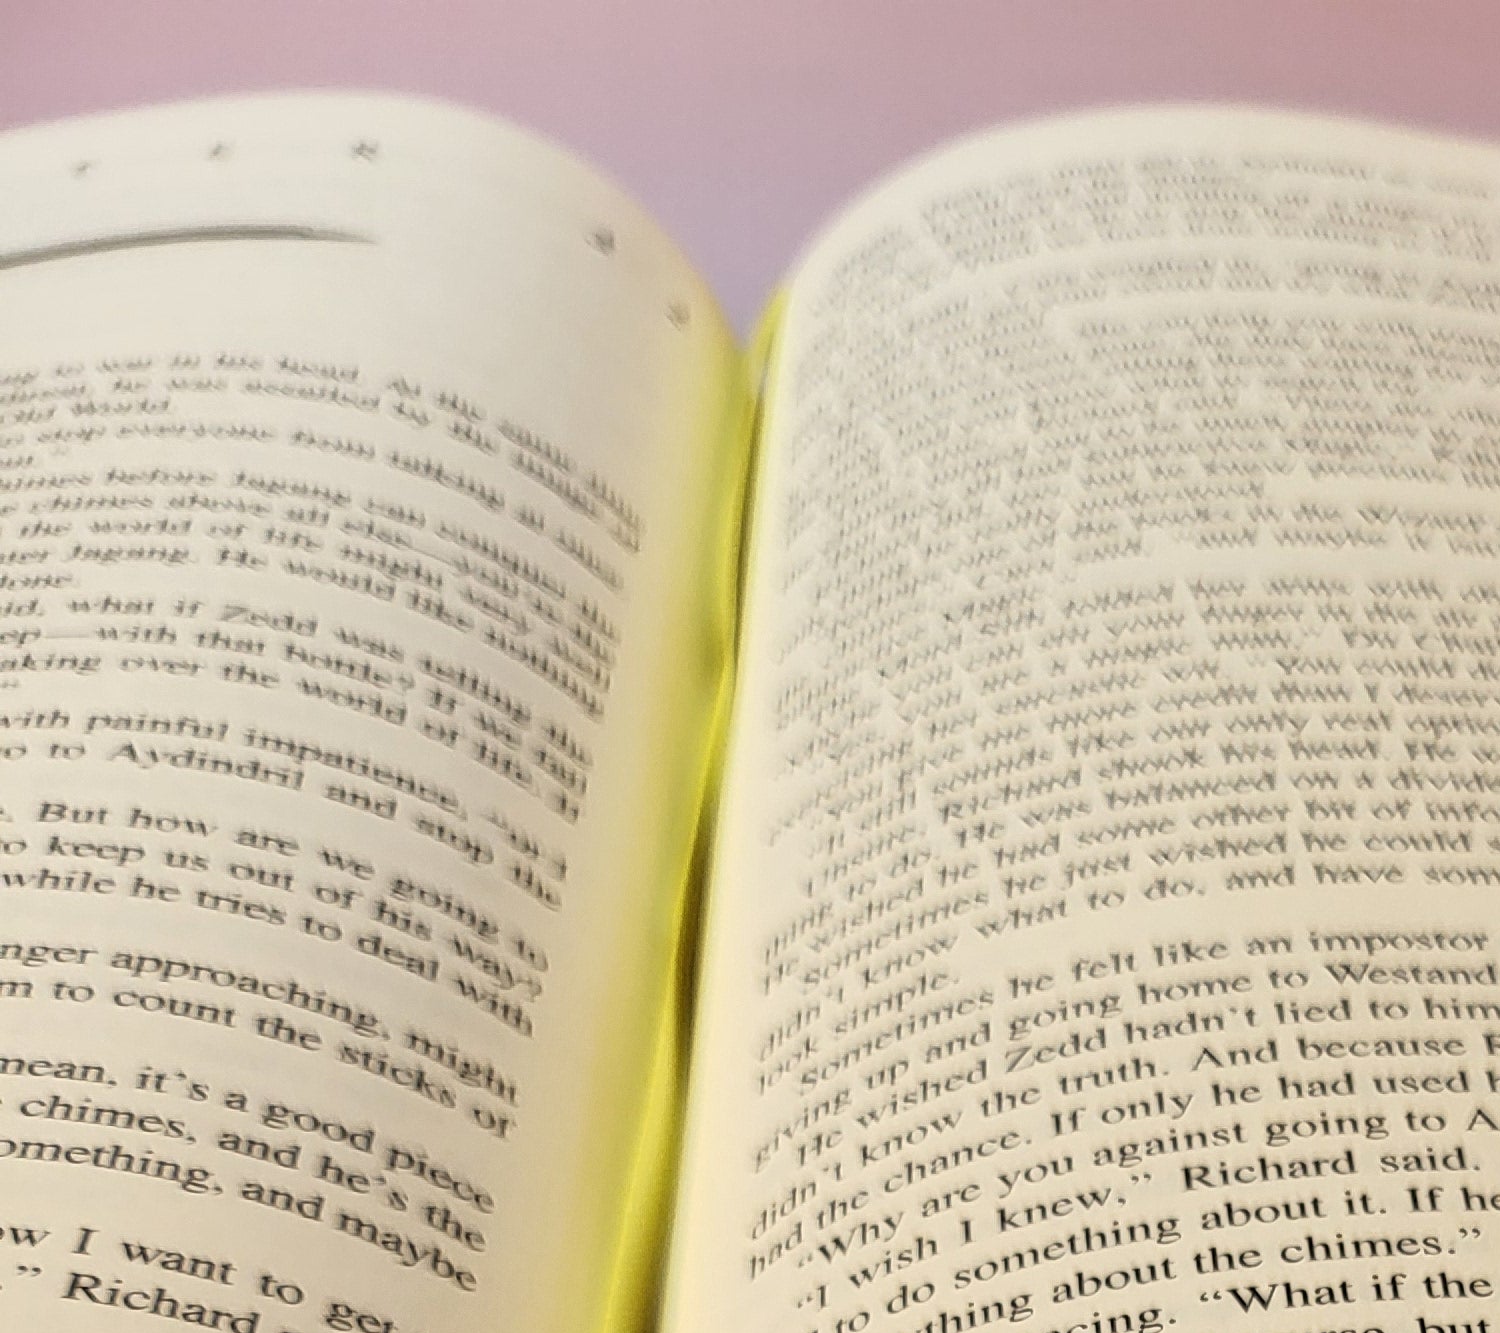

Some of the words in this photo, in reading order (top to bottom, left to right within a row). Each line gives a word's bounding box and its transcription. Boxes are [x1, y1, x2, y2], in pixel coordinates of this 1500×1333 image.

[52, 979, 96, 1004] to
[111, 989, 236, 1029] count
[254, 1015, 322, 1053] the
[338, 1029, 456, 1109] sticks
[109, 950, 390, 1041] approaching,
[405, 1030, 517, 1105] might
[18, 1092, 197, 1144] chimes,
[216, 1130, 302, 1171] and
[316, 1153, 409, 1213] he’s
[423, 1203, 486, 1253] the
[222, 1090, 249, 1114] a
[260, 1101, 376, 1155] good
[385, 1144, 495, 1215] piece
[72, 1225, 97, 1257] I
[120, 1240, 234, 1287] want
[258, 1272, 305, 1307] to
[239, 1180, 326, 1223] and
[336, 1210, 477, 1294] maybe
[847, 1234, 938, 1289] wish
[959, 1217, 973, 1245] I
[1180, 1147, 1357, 1192] Richard
[1379, 1144, 1481, 1174] said.
[885, 1280, 936, 1316] do
[953, 1216, 1182, 1291] something
[1200, 1194, 1323, 1232] about
[1344, 1189, 1387, 1217] it.
[1406, 1185, 1444, 1214] If
[1051, 1256, 1174, 1305] about
[1192, 1244, 1263, 1276] the
[1279, 1225, 1482, 1265] chimes.”
[1198, 1279, 1355, 1315] “What
[1371, 1271, 1408, 1303] if
[1422, 1269, 1494, 1301] the
